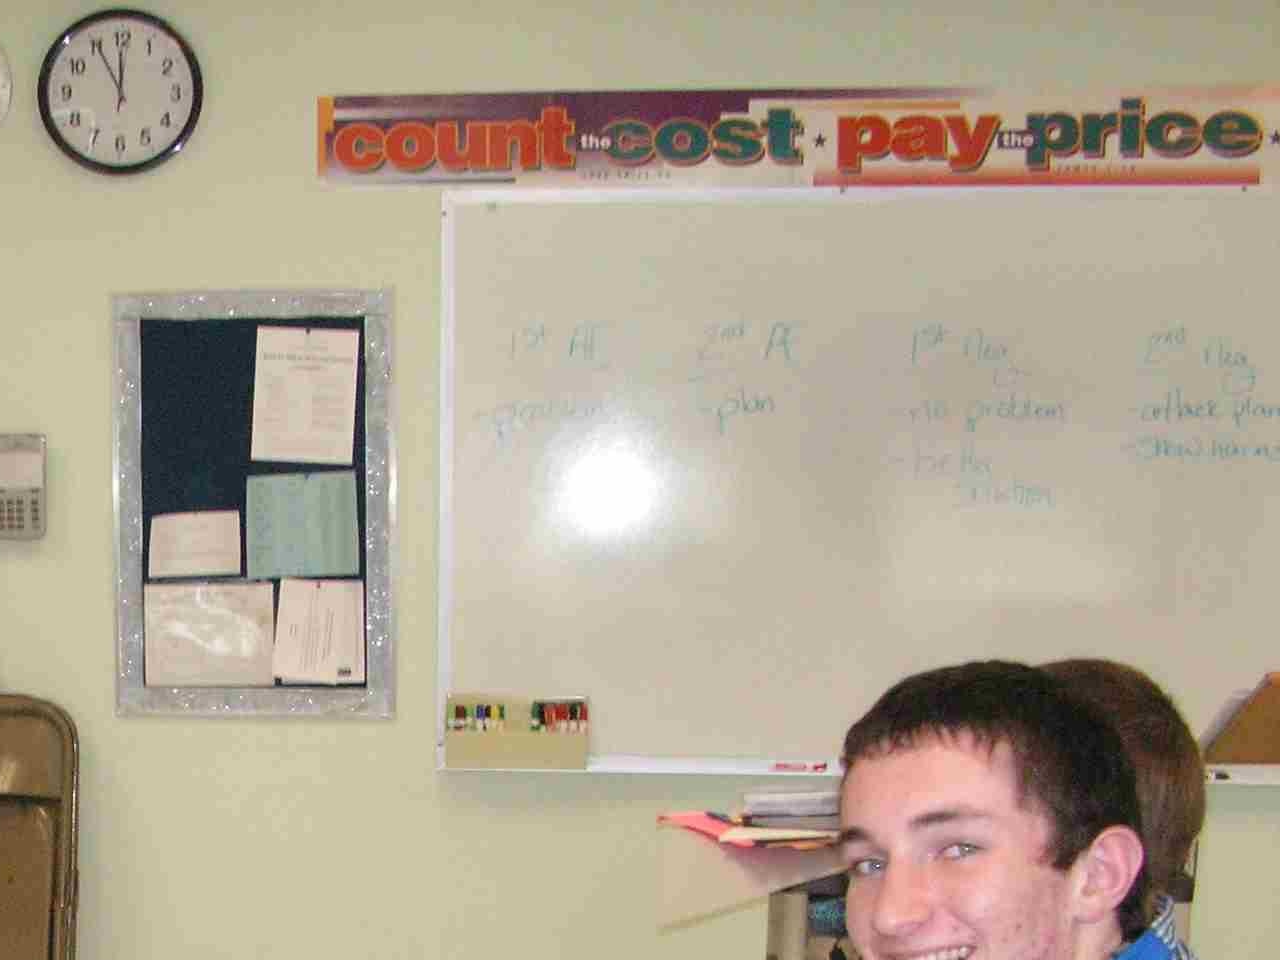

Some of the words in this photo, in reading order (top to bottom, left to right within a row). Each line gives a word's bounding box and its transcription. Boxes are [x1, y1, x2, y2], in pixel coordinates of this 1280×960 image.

[115, 31, 131, 48] 12
[70, 58, 86, 75] 10
[161, 57, 173, 75] 2
[61, 85, 72, 101] 9
[171, 83, 181, 101] 3
[69, 112, 80, 127] 8
[160, 112, 171, 128] 4
[115, 135, 126, 151] 6
[140, 128, 151, 145] 5
[334, 107, 576, 173] count
[580, 133, 611, 149] the
[604, 107, 805, 167] cost
[836, 111, 1001, 173] pay
[995, 131, 1034, 149] the
[1025, 97, 1265, 173] price
